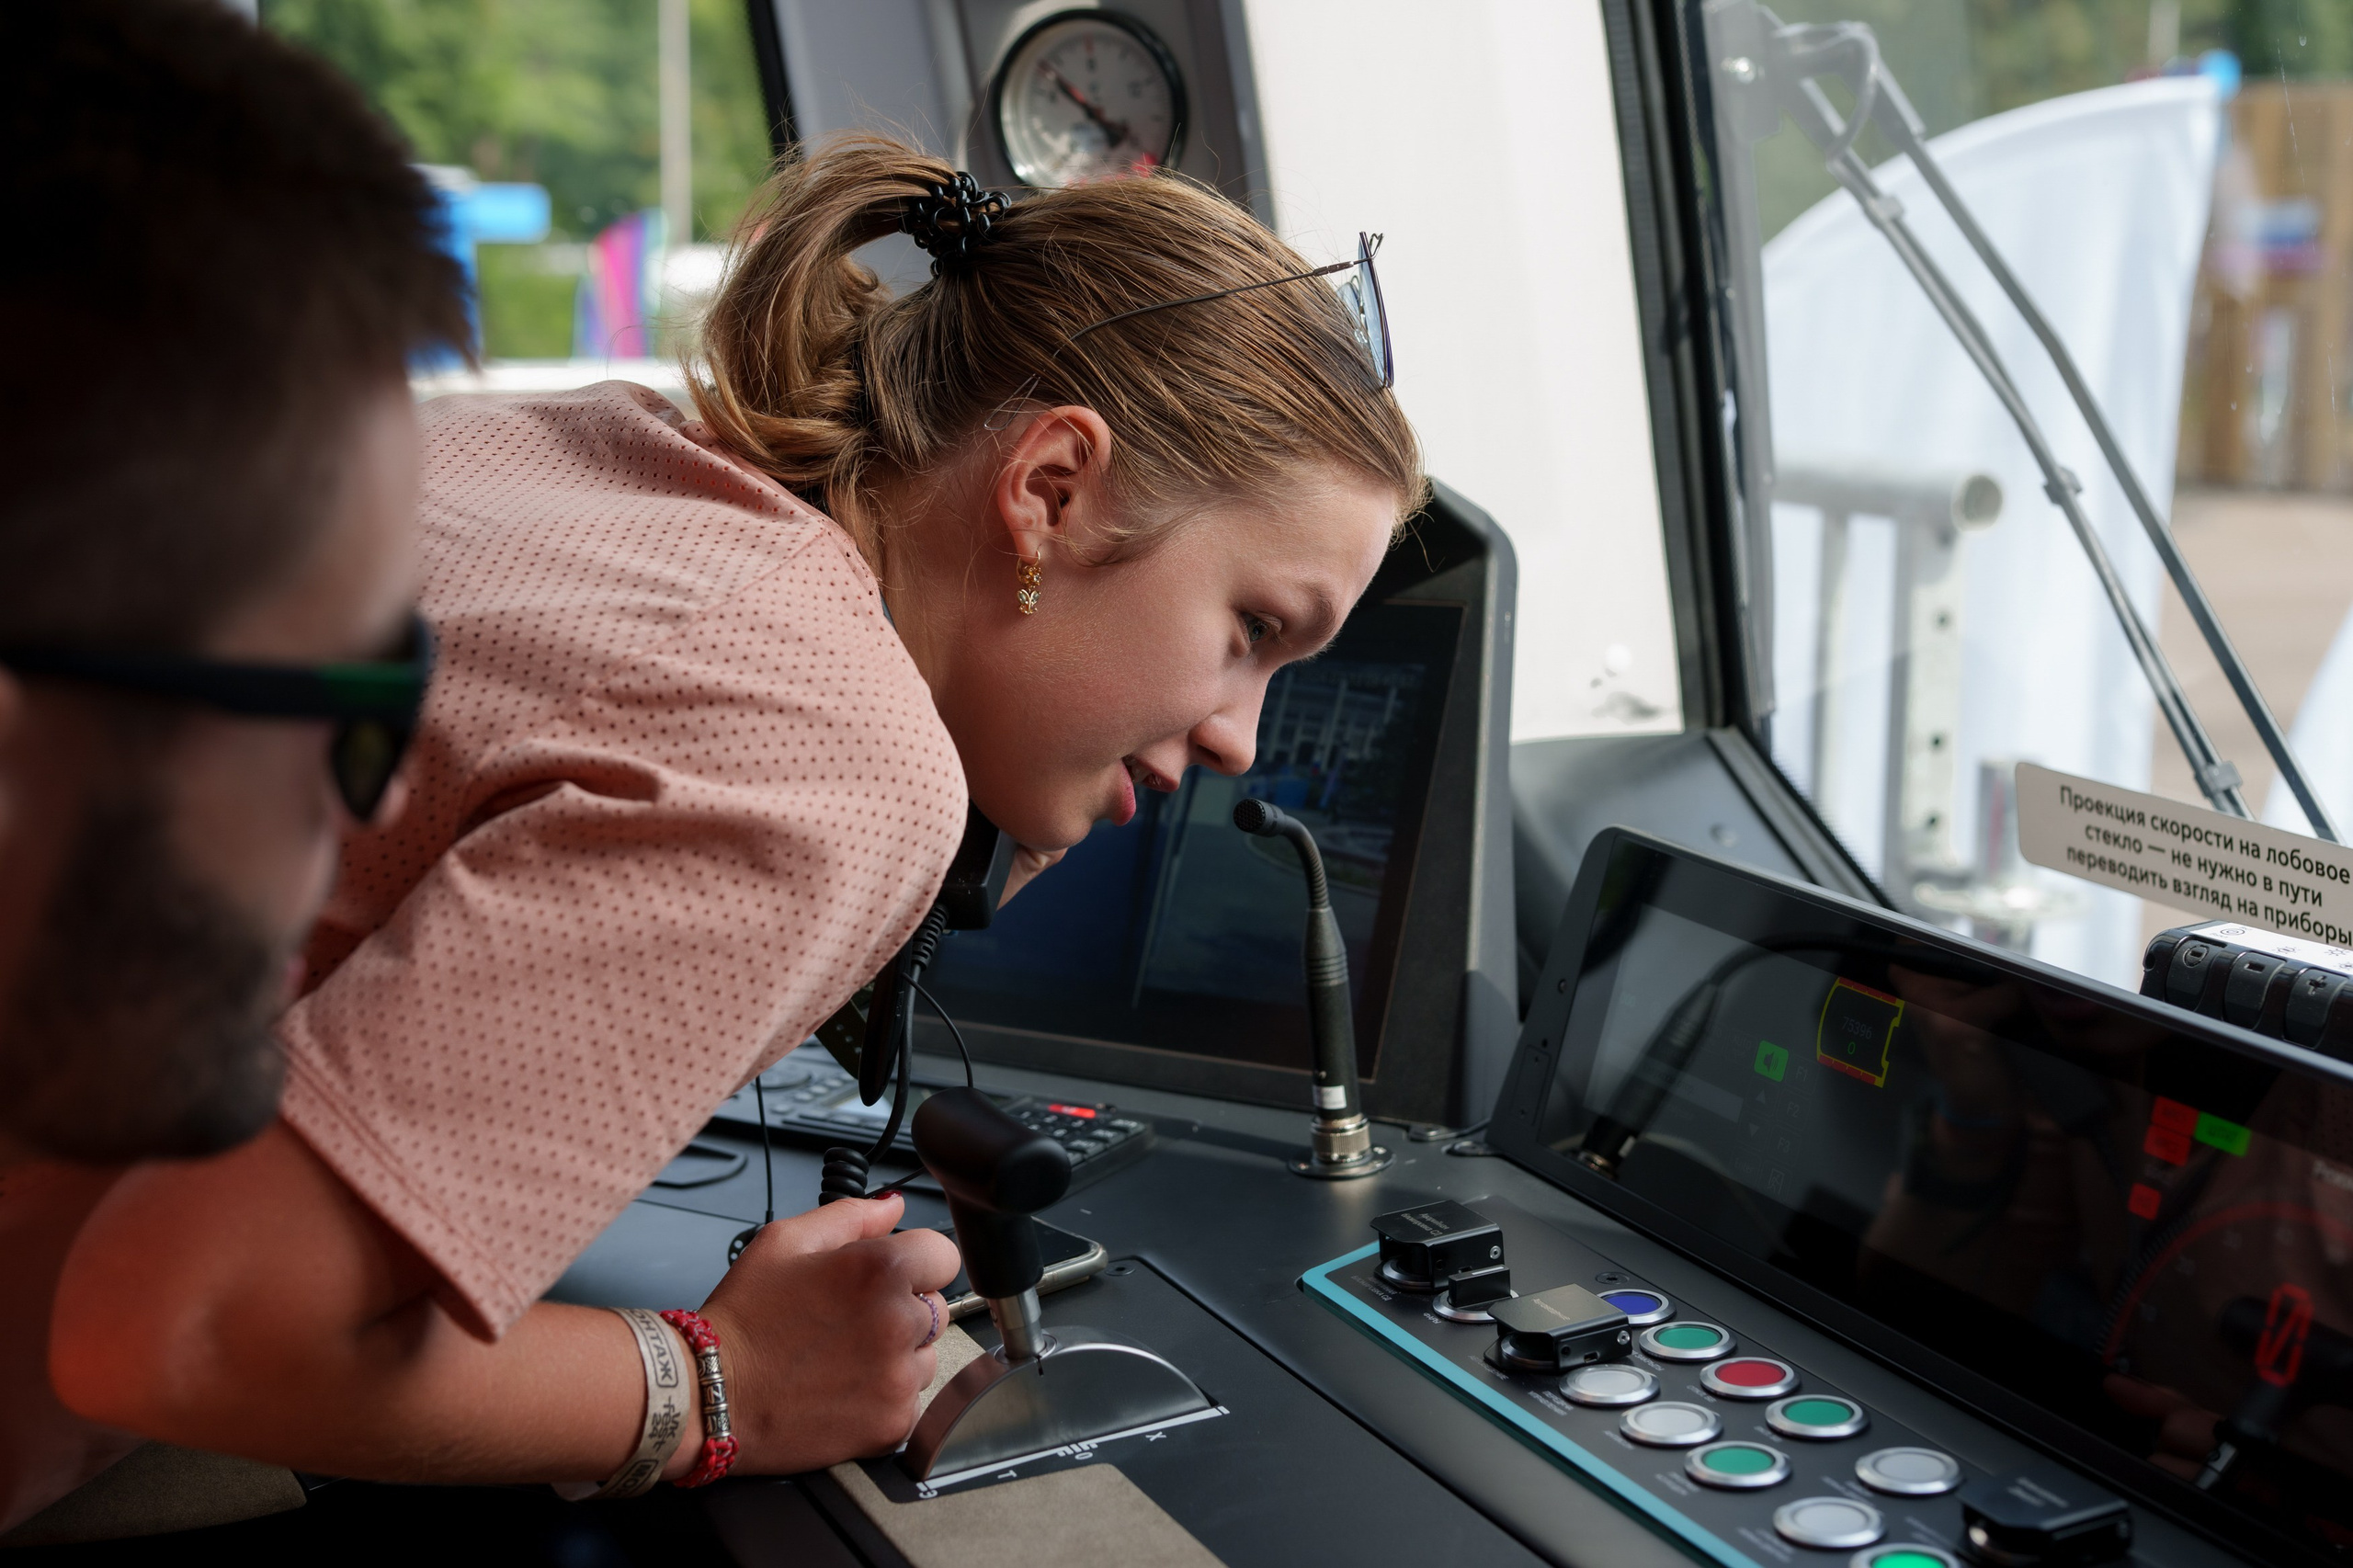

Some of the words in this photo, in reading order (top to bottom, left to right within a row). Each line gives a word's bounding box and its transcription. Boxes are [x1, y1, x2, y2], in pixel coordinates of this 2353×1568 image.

[2060, 785, 2145, 826] Проекция
[2151, 815, 2234, 852] скорости
[2240, 839, 2260, 859] на
[2267, 847, 2350, 884] лобовое
[2086, 825, 2143, 854] стекло
[2171, 848, 2192, 868] не
[2198, 857, 2256, 887] нужно
[2264, 875, 2273, 892] в
[2279, 881, 2322, 907] пути
[2067, 846, 2167, 890] переводить
[2173, 879, 2232, 913] взгляд
[2238, 897, 2257, 917] на
[2265, 906, 2352, 947] приборы
[1841, 1016, 1872, 1040] 75396
[1847, 1041, 1856, 1055] 0
[1795, 1065, 1808, 1082] F1
[1786, 1101, 1801, 1119] F2
[1777, 1136, 1790, 1153] F3
[630, 1309, 673, 1381] ОНТАЖ
